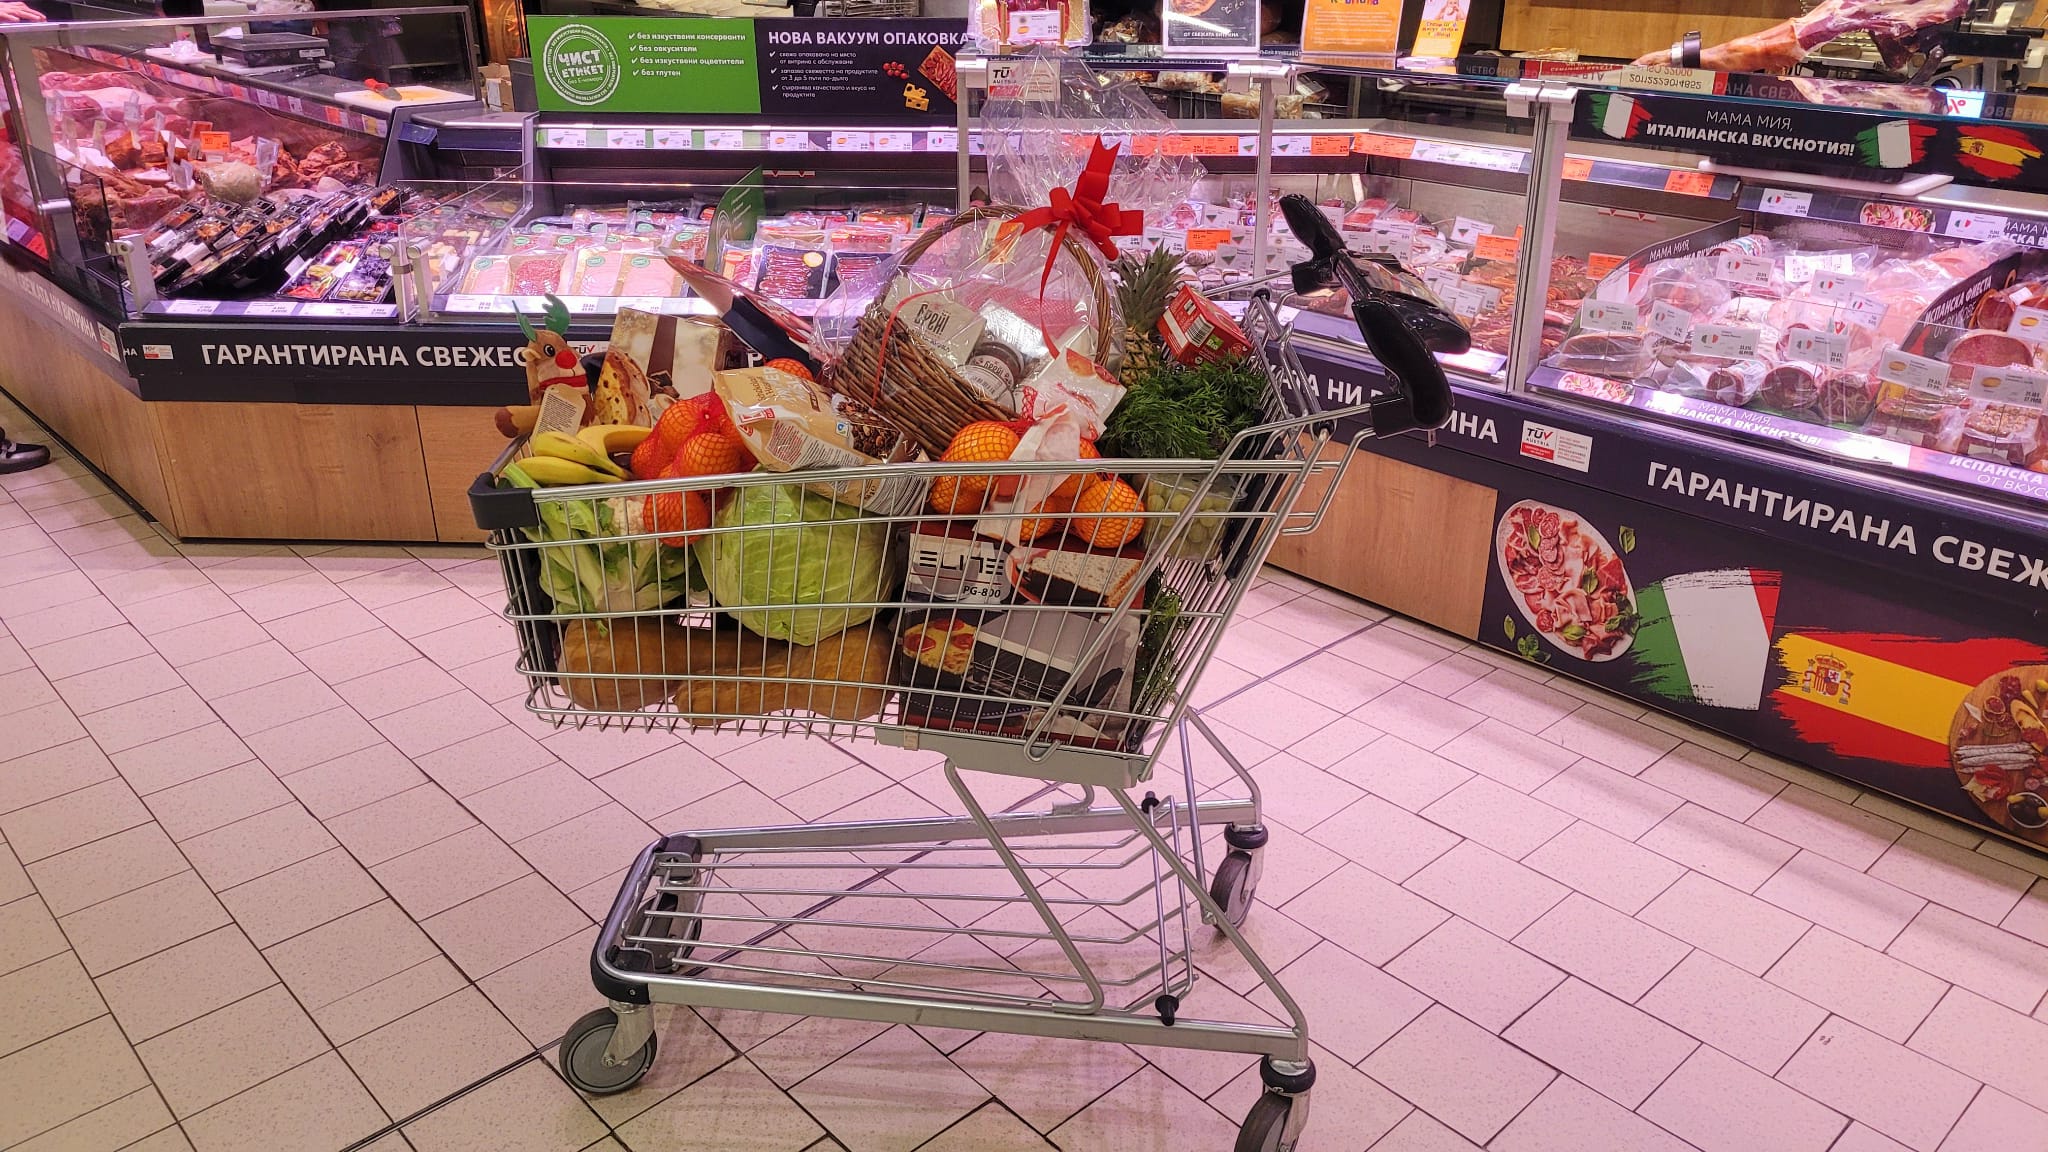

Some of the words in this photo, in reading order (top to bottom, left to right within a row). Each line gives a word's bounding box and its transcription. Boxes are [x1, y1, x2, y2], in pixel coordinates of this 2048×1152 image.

[697, 34, 746, 42] консерванти
[769, 31, 812, 44] НОВА
[816, 32, 879, 44] ВАКУУМ
[884, 32, 969, 45] ОПАКОВКА
[558, 50, 601, 66] ЧИСТ
[700, 58, 744, 66] оцветители
[562, 65, 605, 78] ЕТИКЕТ
[1706, 110, 1752, 128] МАМА
[1757, 114, 1793, 133] МИЯ,
[1646, 124, 1749, 148] ИТАЛИАНСКА
[1752, 133, 1856, 157] ВКУСНОТИЯ!
[1966, 275, 1992, 302] ФИЕСТА
[201, 344, 410, 368] ГАРАНТИРАНА
[1327, 378, 1363, 406] НИ
[1698, 402, 1738, 418] МАМА
[1742, 411, 1772, 427] МИЯ,
[1526, 437, 1552, 447] AUSTRIA
[1527, 428, 1554, 441] TÜV
[1949, 456, 2043, 485] ИСПАНСКА
[1977, 474, 2001, 486] ОТ
[1646, 461, 1917, 556] ГАРАНТИРАНА
[963, 585, 1002, 600] PG-800
